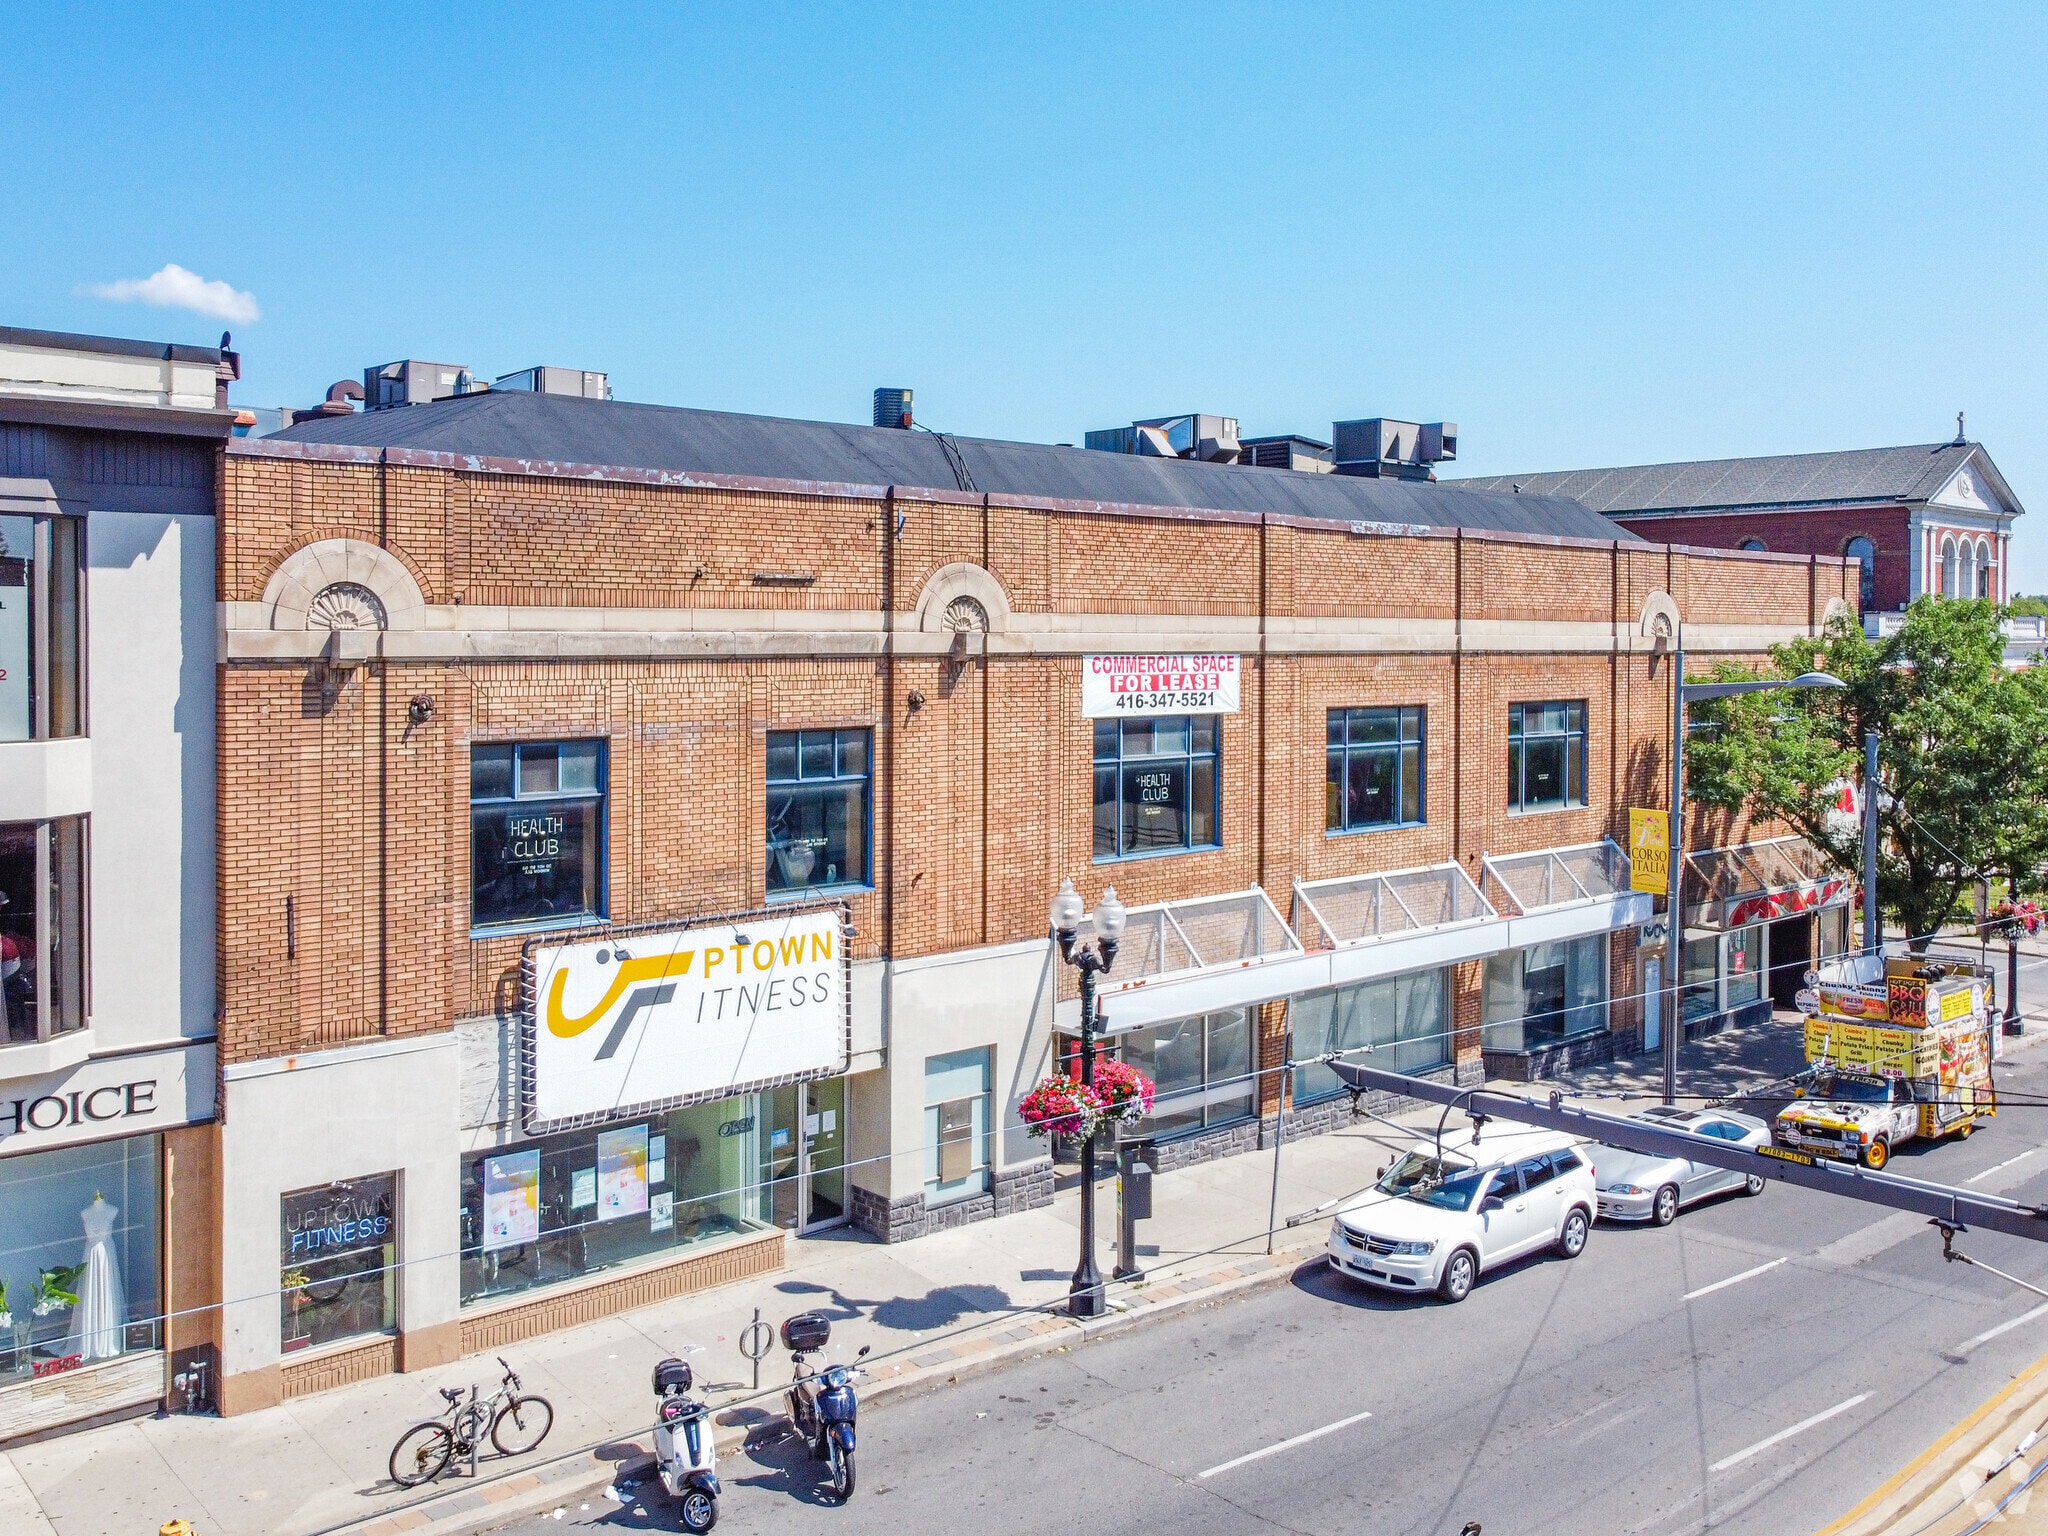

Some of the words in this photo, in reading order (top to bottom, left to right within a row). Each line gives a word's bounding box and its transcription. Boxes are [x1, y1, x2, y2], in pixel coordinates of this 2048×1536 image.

[1092, 655, 1188, 674] COMMERCIAL
[1193, 655, 1235, 672] SPACE
[1113, 675, 1152, 692] FOR
[1158, 674, 1217, 691] LEASE
[1116, 692, 1214, 709] 416-347-5521
[1140, 773, 1171, 787] HEALTH
[1142, 787, 1169, 800] CLUB
[511, 817, 563, 836] HEALTH
[514, 838, 559, 857] CLUB
[1632, 848, 1667, 862] CORSO
[1632, 860, 1666, 874] ITALIA
[1820, 981, 1853, 990] Chunky
[1855, 985, 1887, 994] Skinny
[1890, 984, 1925, 1001] BBQ
[1842, 996, 1863, 1004] FRESH
[1920, 1032, 1936, 1042] STREET
[1923, 1065, 1933, 1074] FOOD
[719, 1116, 755, 1137] OPEN
[286, 1192, 392, 1232] UPTOWN
[291, 1215, 387, 1253] FITNESS
